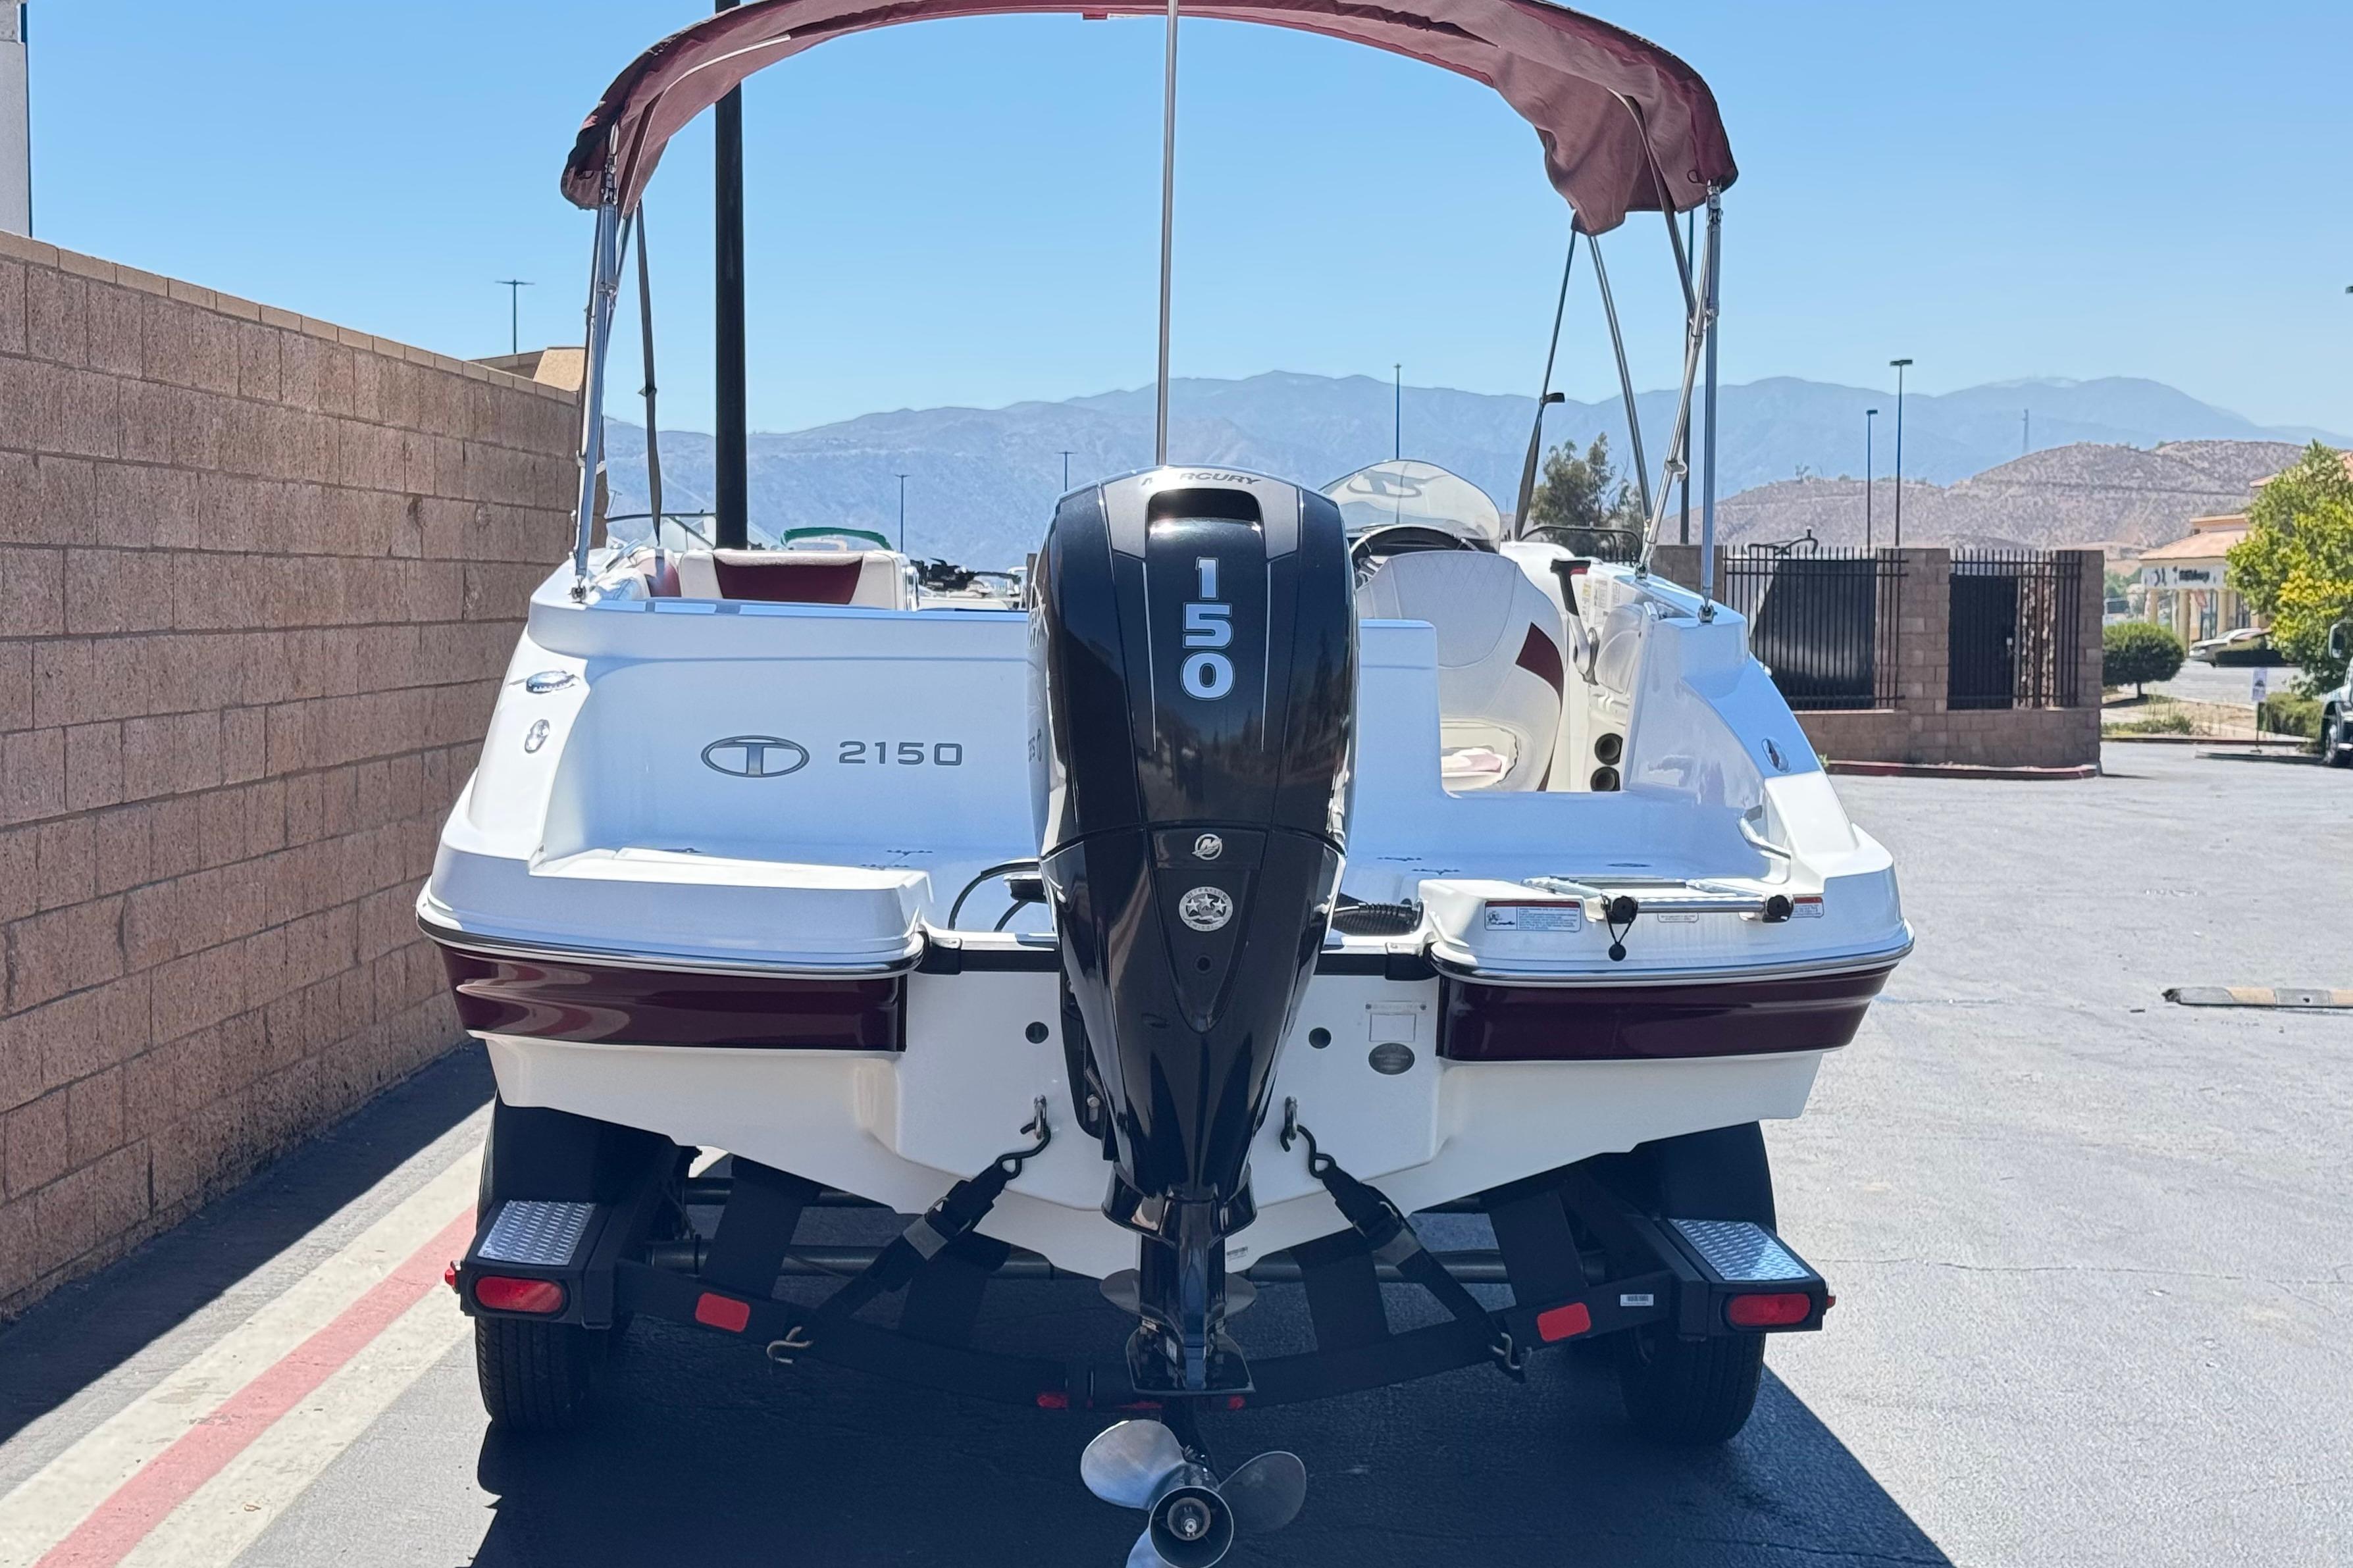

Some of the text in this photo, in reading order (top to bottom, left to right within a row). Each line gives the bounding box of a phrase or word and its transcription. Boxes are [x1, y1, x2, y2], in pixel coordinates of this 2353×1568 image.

[1141, 472, 1261, 486] MRCURY
[1180, 557, 1235, 701] 150
[839, 741, 963, 766] 2150
